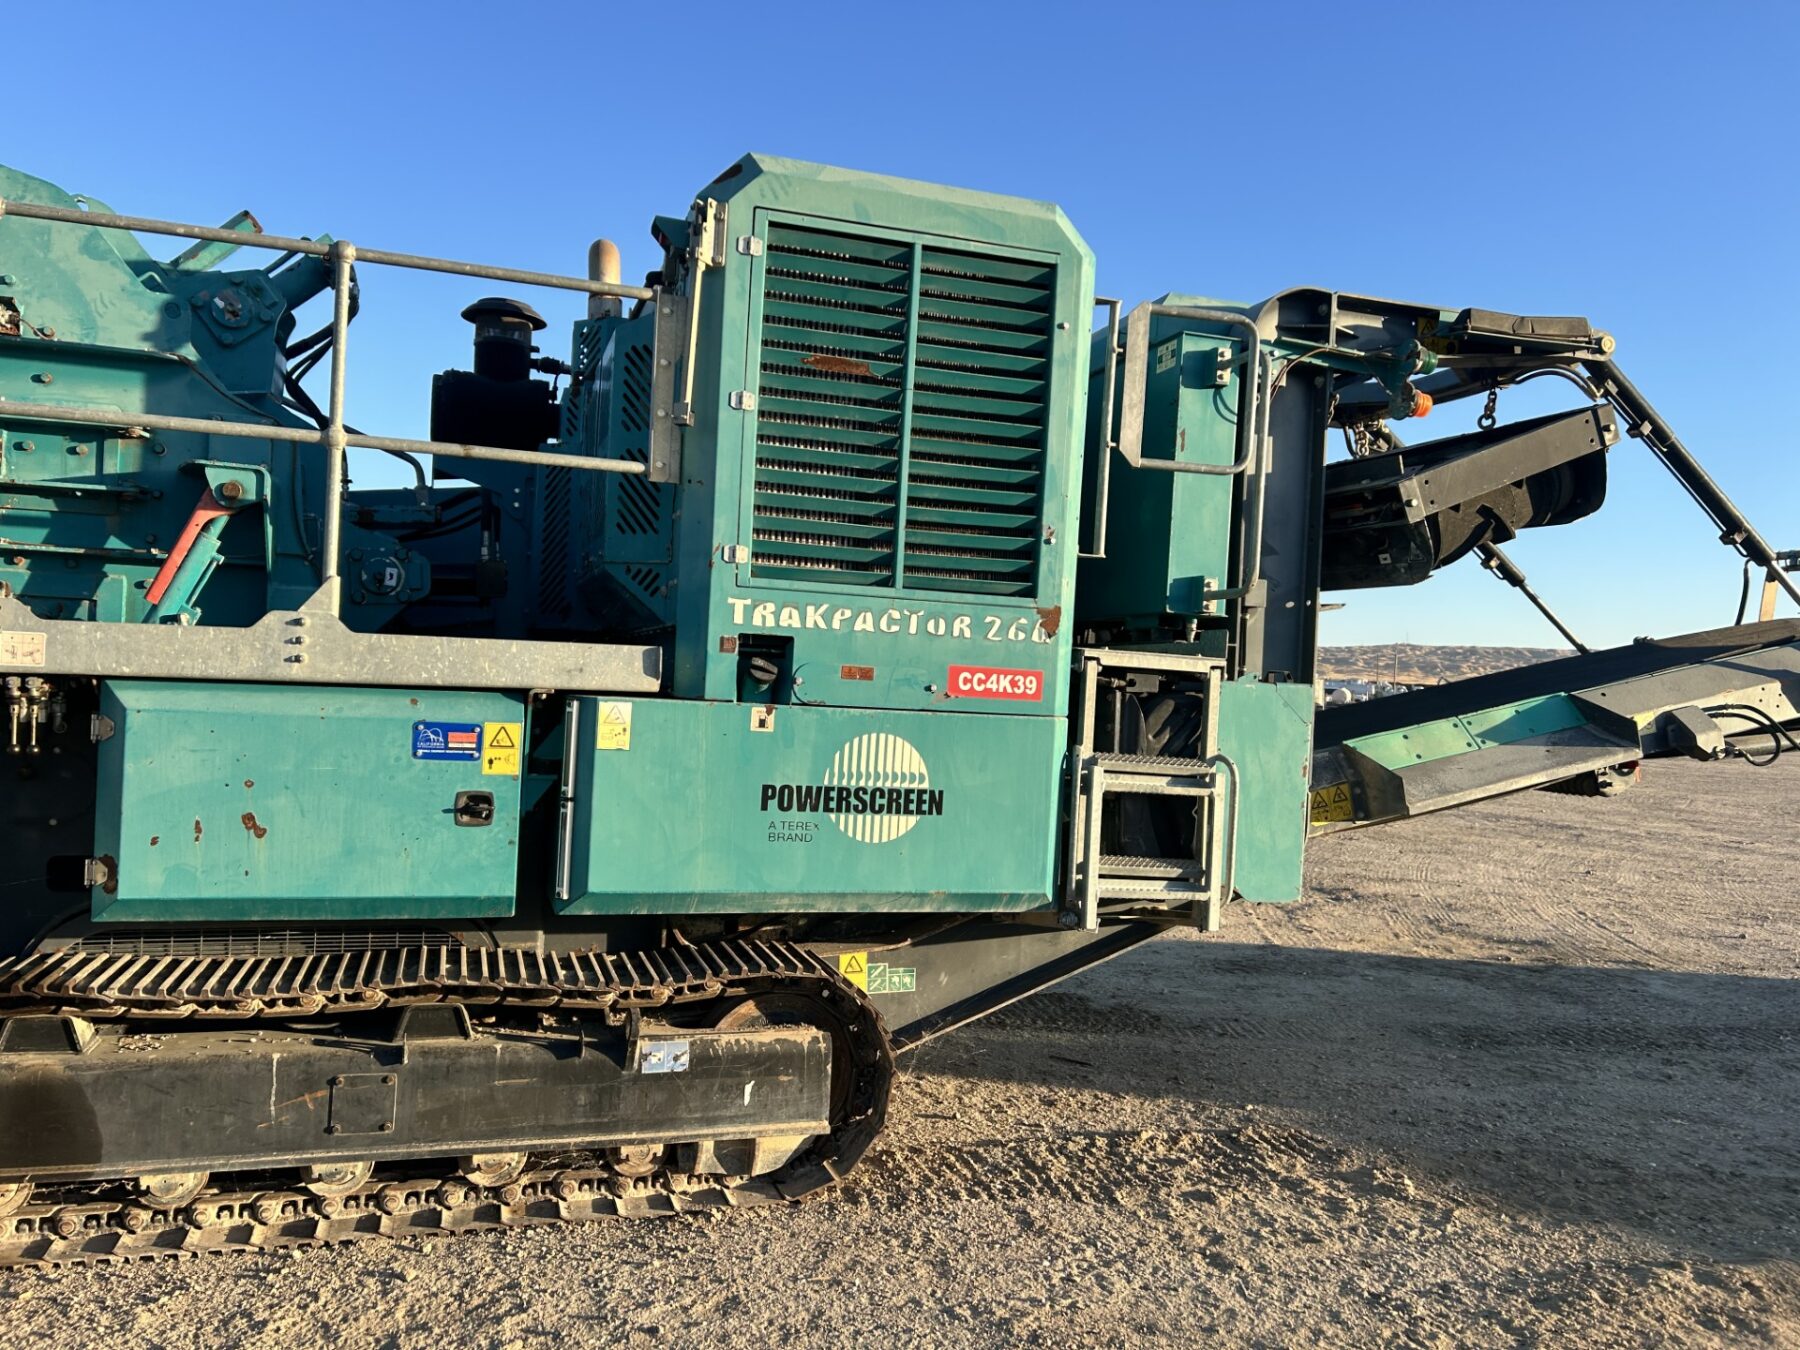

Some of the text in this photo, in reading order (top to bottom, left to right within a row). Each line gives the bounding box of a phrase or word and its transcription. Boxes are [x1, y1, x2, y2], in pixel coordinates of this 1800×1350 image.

[727, 597, 971, 639] TRAKPACTOR
[958, 671, 1037, 695] CC4K39
[760, 784, 944, 816] POWERSCREEN
[768, 821, 820, 831] A TEREX
[768, 832, 813, 843] BRAND
